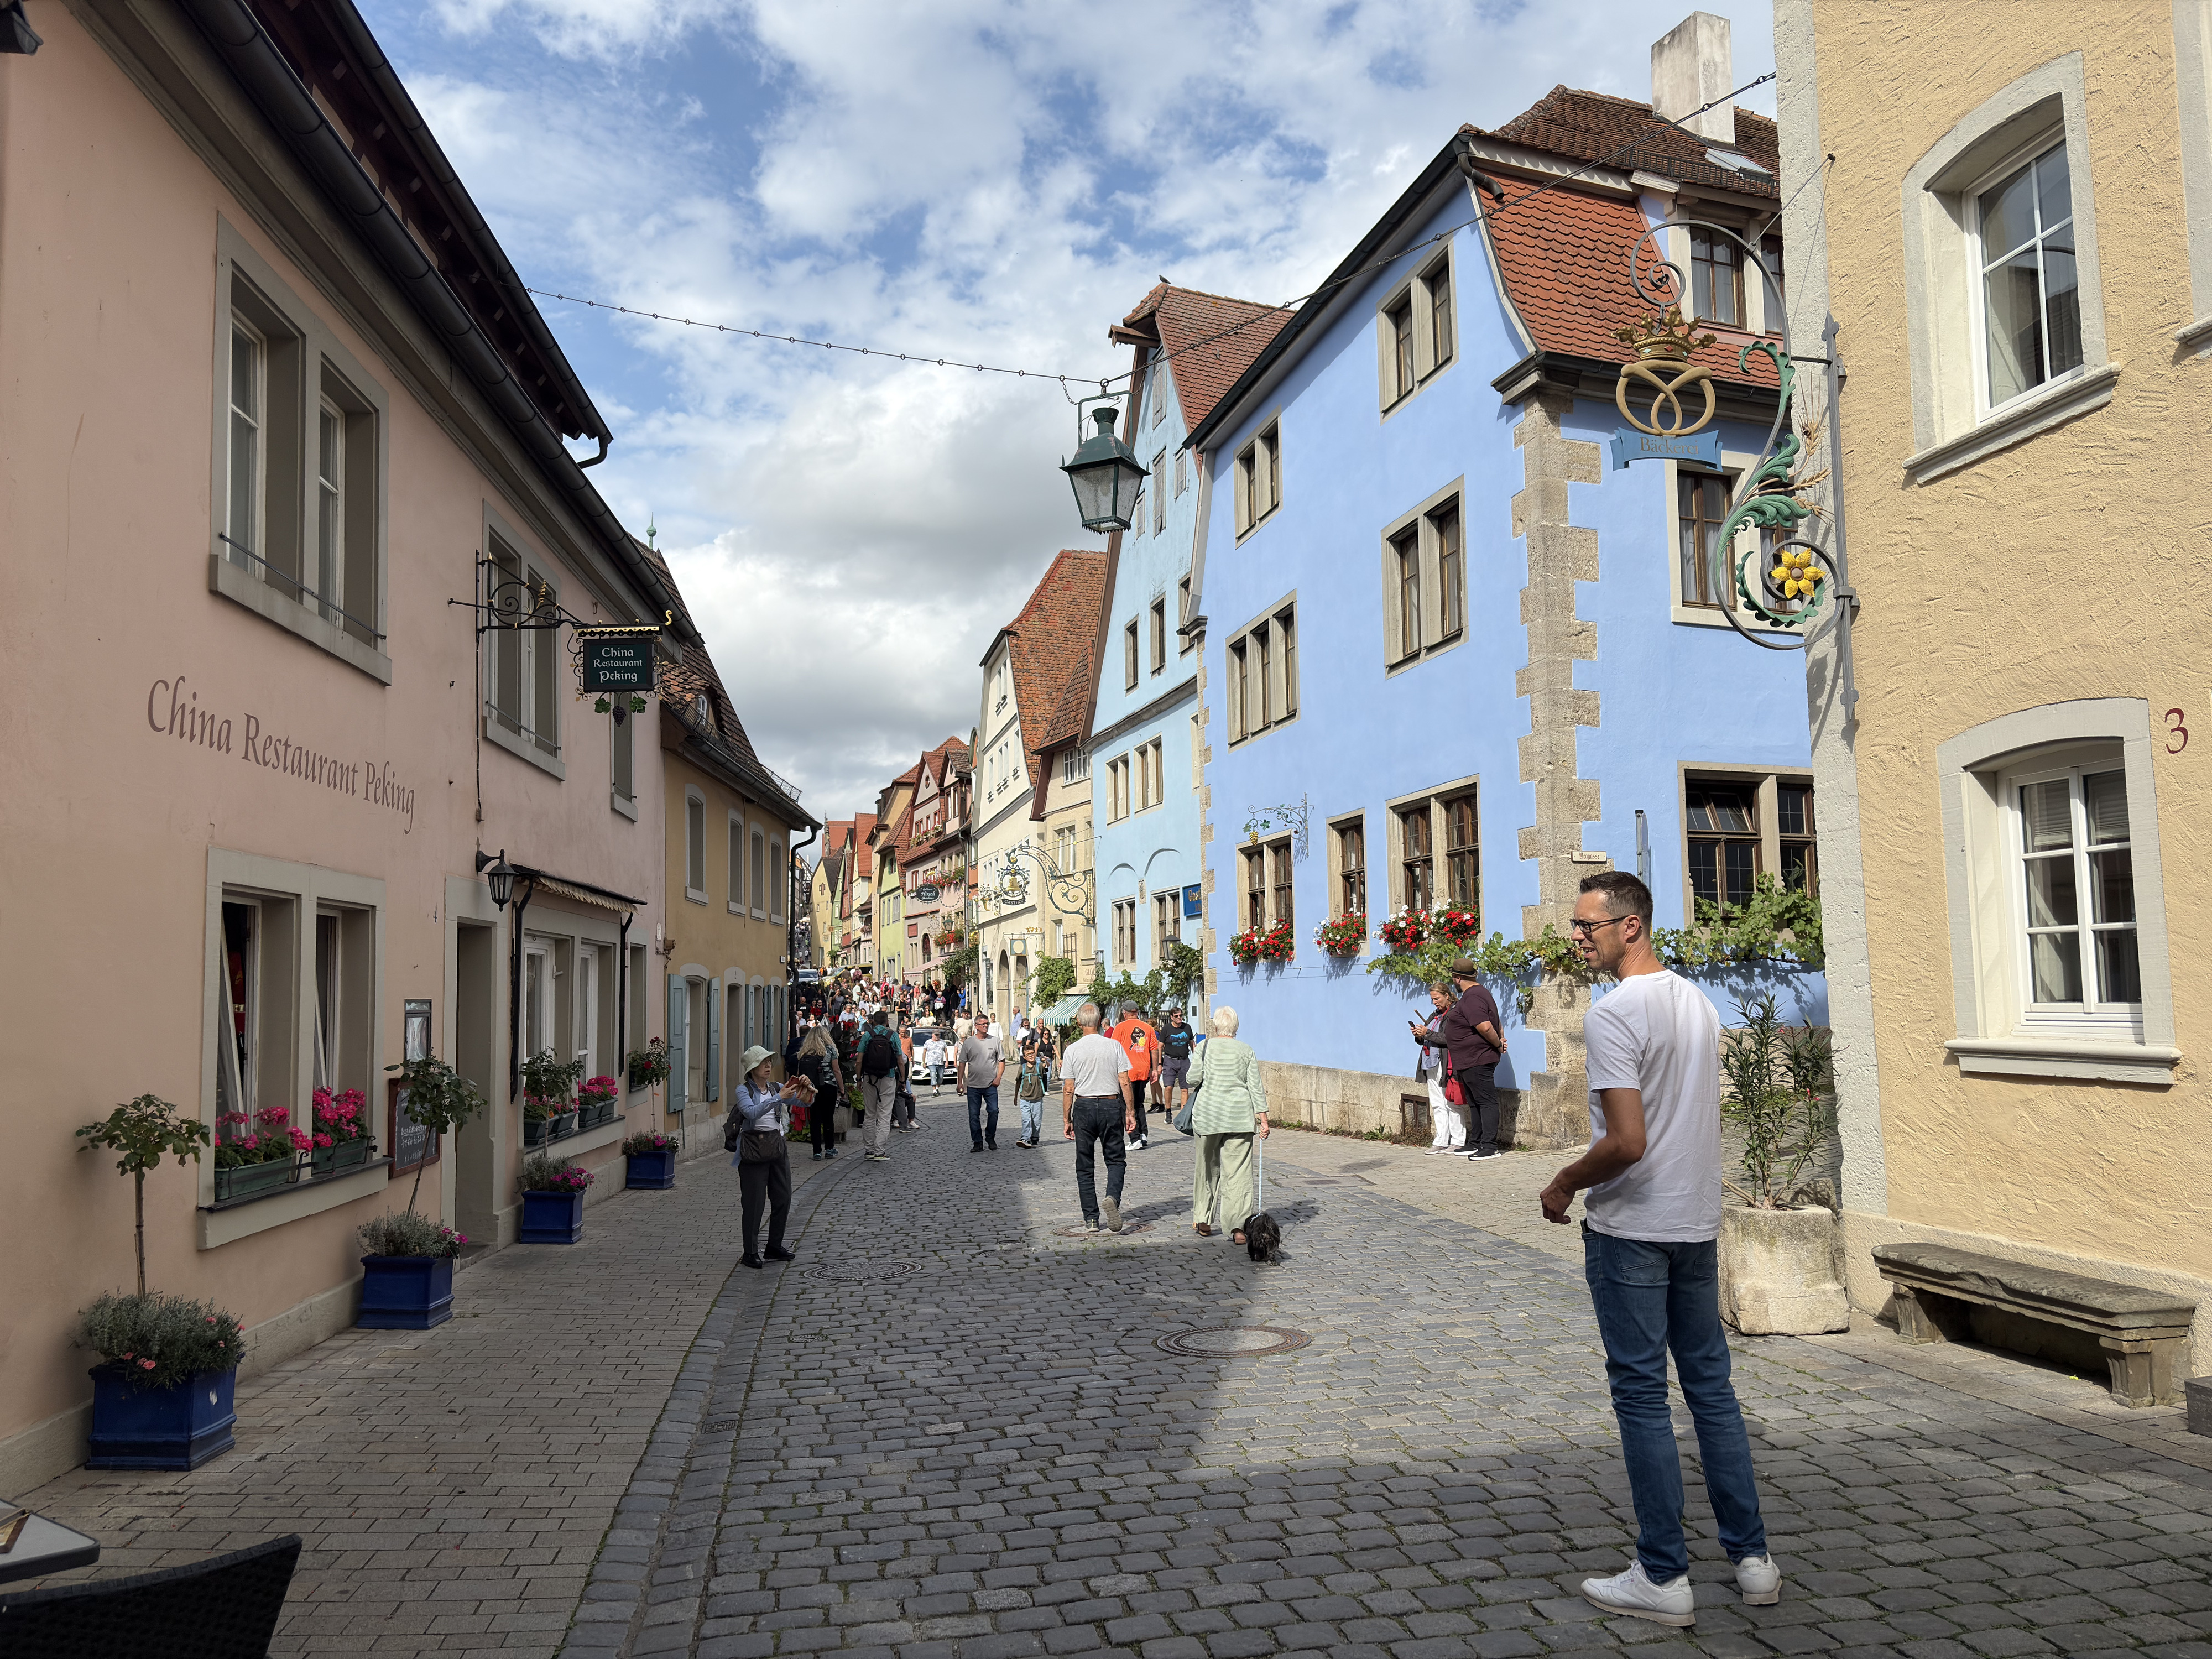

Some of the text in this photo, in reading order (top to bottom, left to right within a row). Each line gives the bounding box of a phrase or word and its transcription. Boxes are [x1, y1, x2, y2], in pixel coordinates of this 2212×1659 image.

[1640, 437, 1699, 455] Bäckerei
[601, 647, 634, 658] China
[593, 659, 643, 667] Restaurant
[599, 670, 638, 683] Peking
[2164, 708, 2188, 754] 3
[147, 675, 416, 834] China Restaurant Peking
[1188, 888, 1202, 902] Gast
[1086, 968, 1095, 976] GLOC
